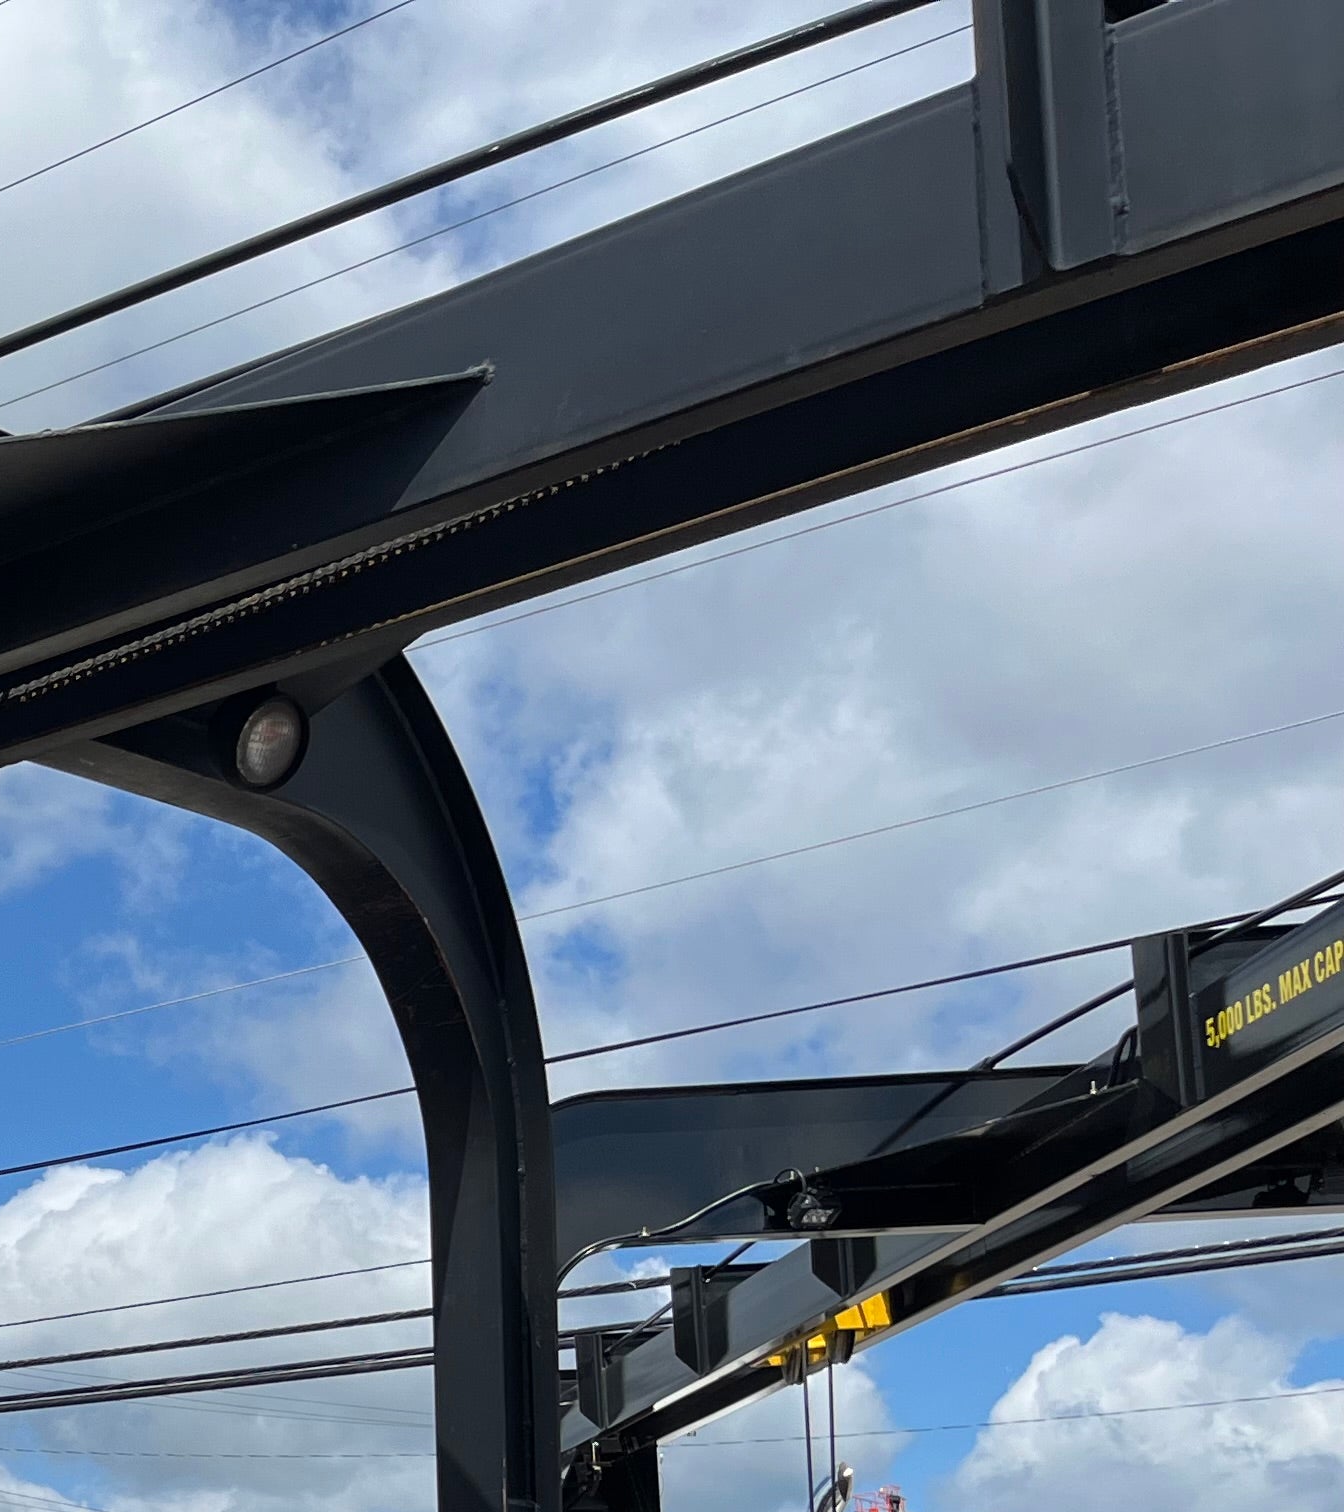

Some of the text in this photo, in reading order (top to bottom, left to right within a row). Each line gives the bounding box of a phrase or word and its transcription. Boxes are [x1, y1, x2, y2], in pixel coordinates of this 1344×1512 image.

[1205, 940, 1344, 1049] 5,000 LBS. MAX CAP
